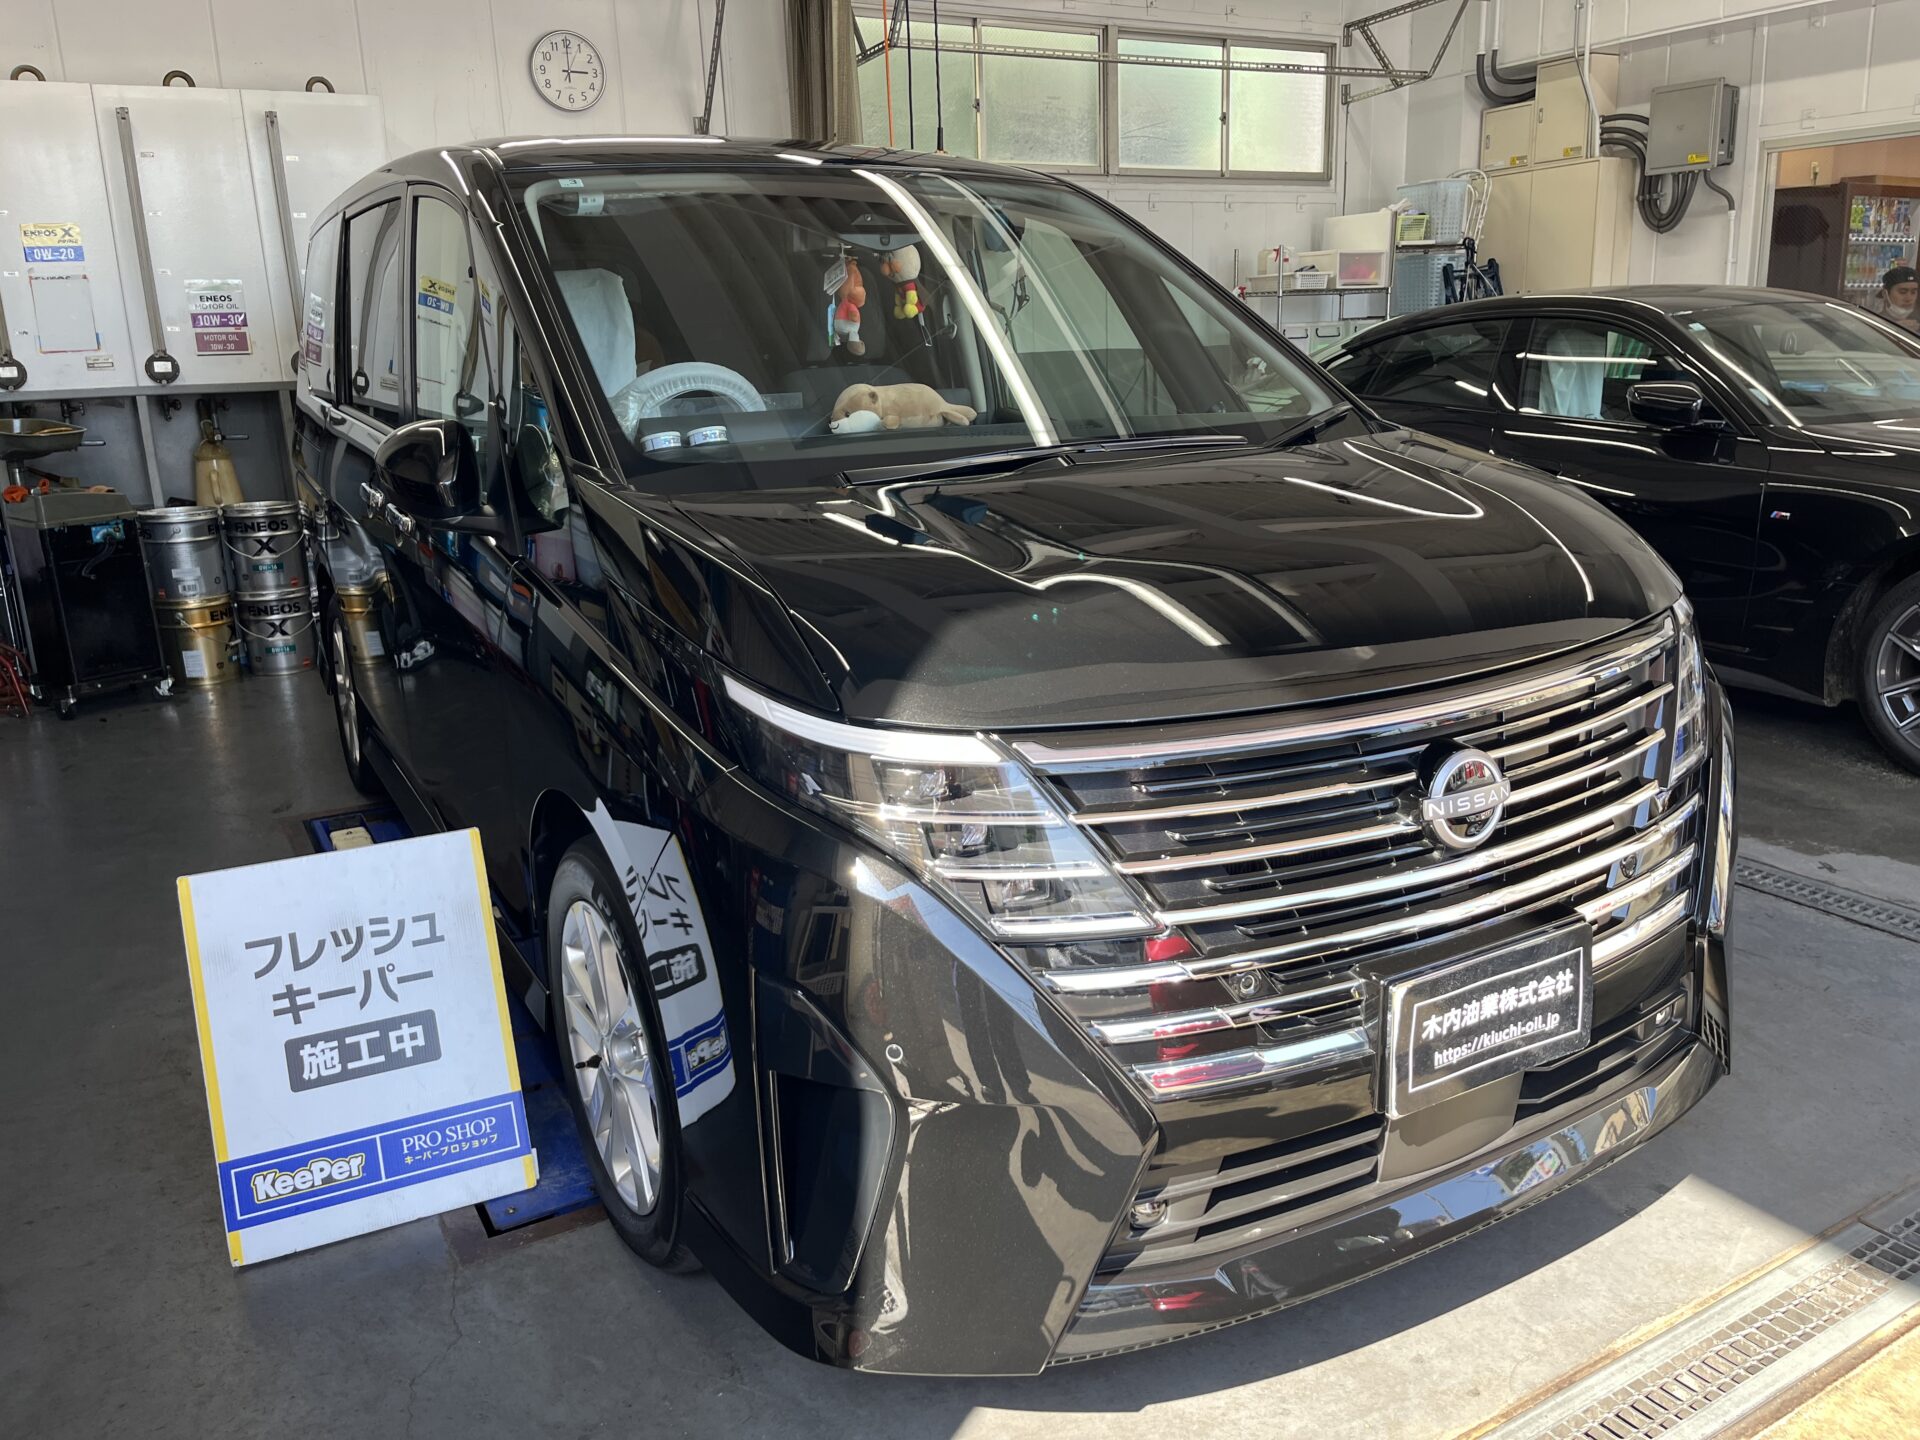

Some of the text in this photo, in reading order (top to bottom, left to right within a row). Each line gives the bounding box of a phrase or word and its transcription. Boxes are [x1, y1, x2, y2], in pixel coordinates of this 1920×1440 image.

[550, 42, 558, 51] 11
[561, 38, 571, 49] 12
[577, 43, 581, 53] 1
[542, 51, 552, 61] 10
[587, 54, 593, 64] 2
[540, 65, 546, 75] 9
[592, 68, 598, 78] 3
[545, 79, 551, 88] 8
[589, 82, 595, 92] 4
[556, 90, 562, 99] 7
[568, 94, 575, 103] 6
[581, 91, 587, 101] 5
[34, 248, 75, 260] 0W-20
[199, 294, 233, 303] ENEOS
[197, 314, 242, 326] 10W-30
[236, 519, 289, 534] ENEOS
[252, 536, 277, 557] X
[249, 602, 301, 617] ENEOS
[266, 619, 291, 638] X
[1428, 784, 1510, 818] NISSAN
[245, 912, 446, 980] フレッシュ
[272, 962, 434, 1025] キーパー
[1421, 967, 1574, 1041] 木内油業株式会社
[1433, 1012, 1560, 1069] https://kiuchi-oil.jp
[299, 1022, 426, 1081] 施工中
[401, 1115, 497, 1154] PRO SHOP
[404, 1133, 499, 1166] キーパープロショップ
[251, 1153, 365, 1204] KeePer
